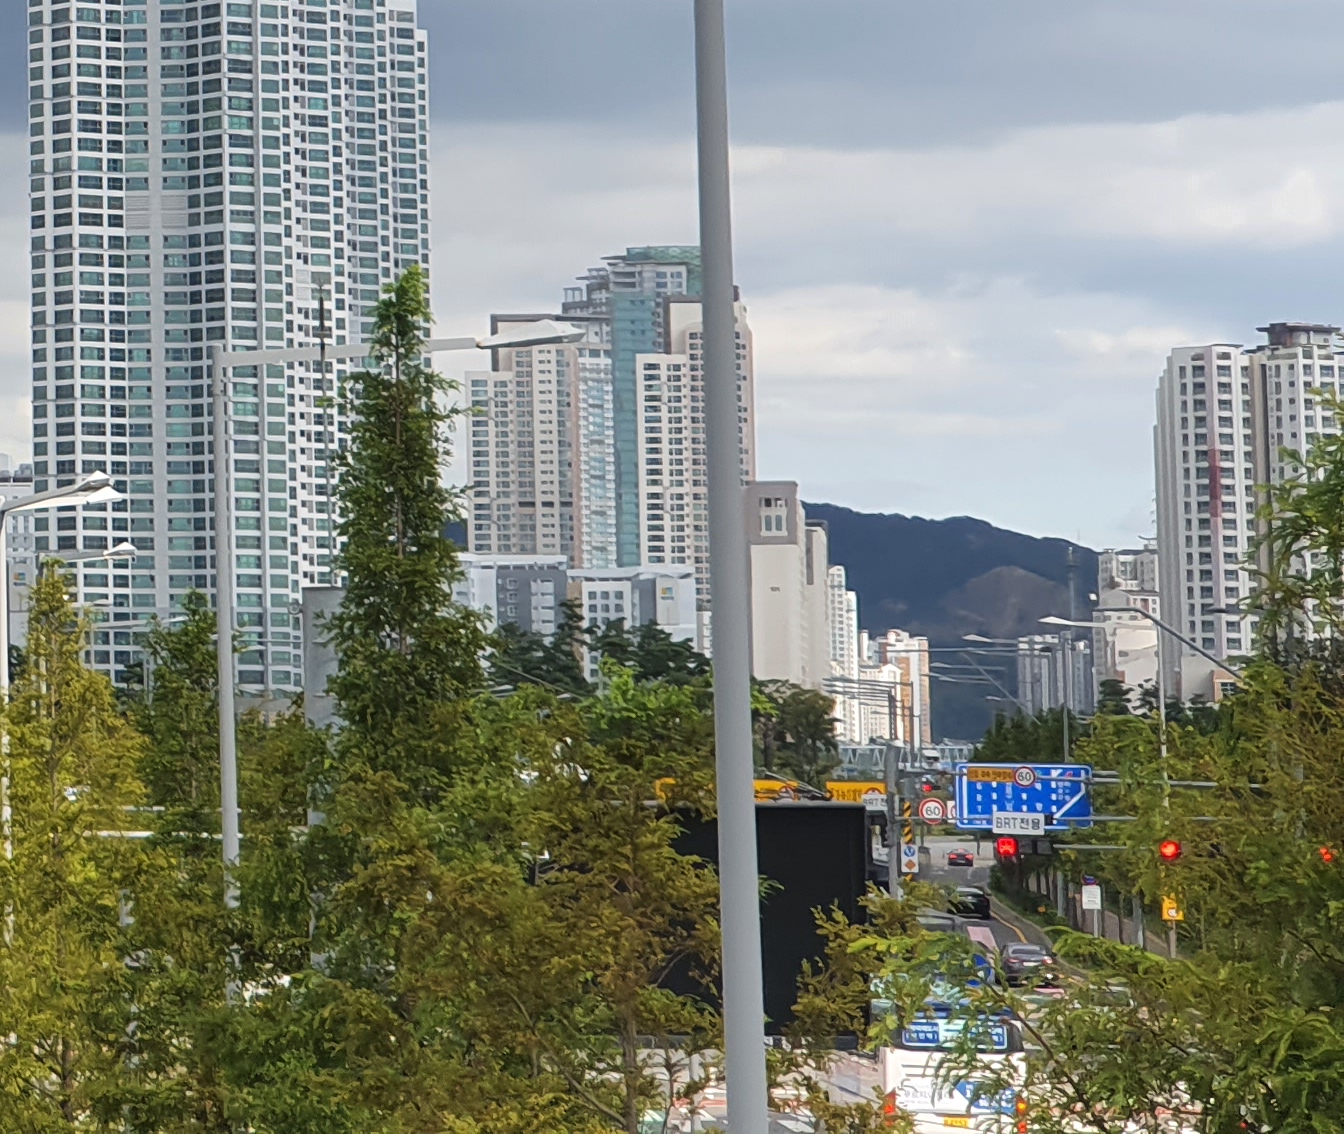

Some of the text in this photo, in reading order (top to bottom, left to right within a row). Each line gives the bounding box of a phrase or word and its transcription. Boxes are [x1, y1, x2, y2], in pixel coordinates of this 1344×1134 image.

[1017, 771, 1032, 782] 60
[925, 806, 941, 816] 60
[995, 817, 1041, 830] BRT전용
